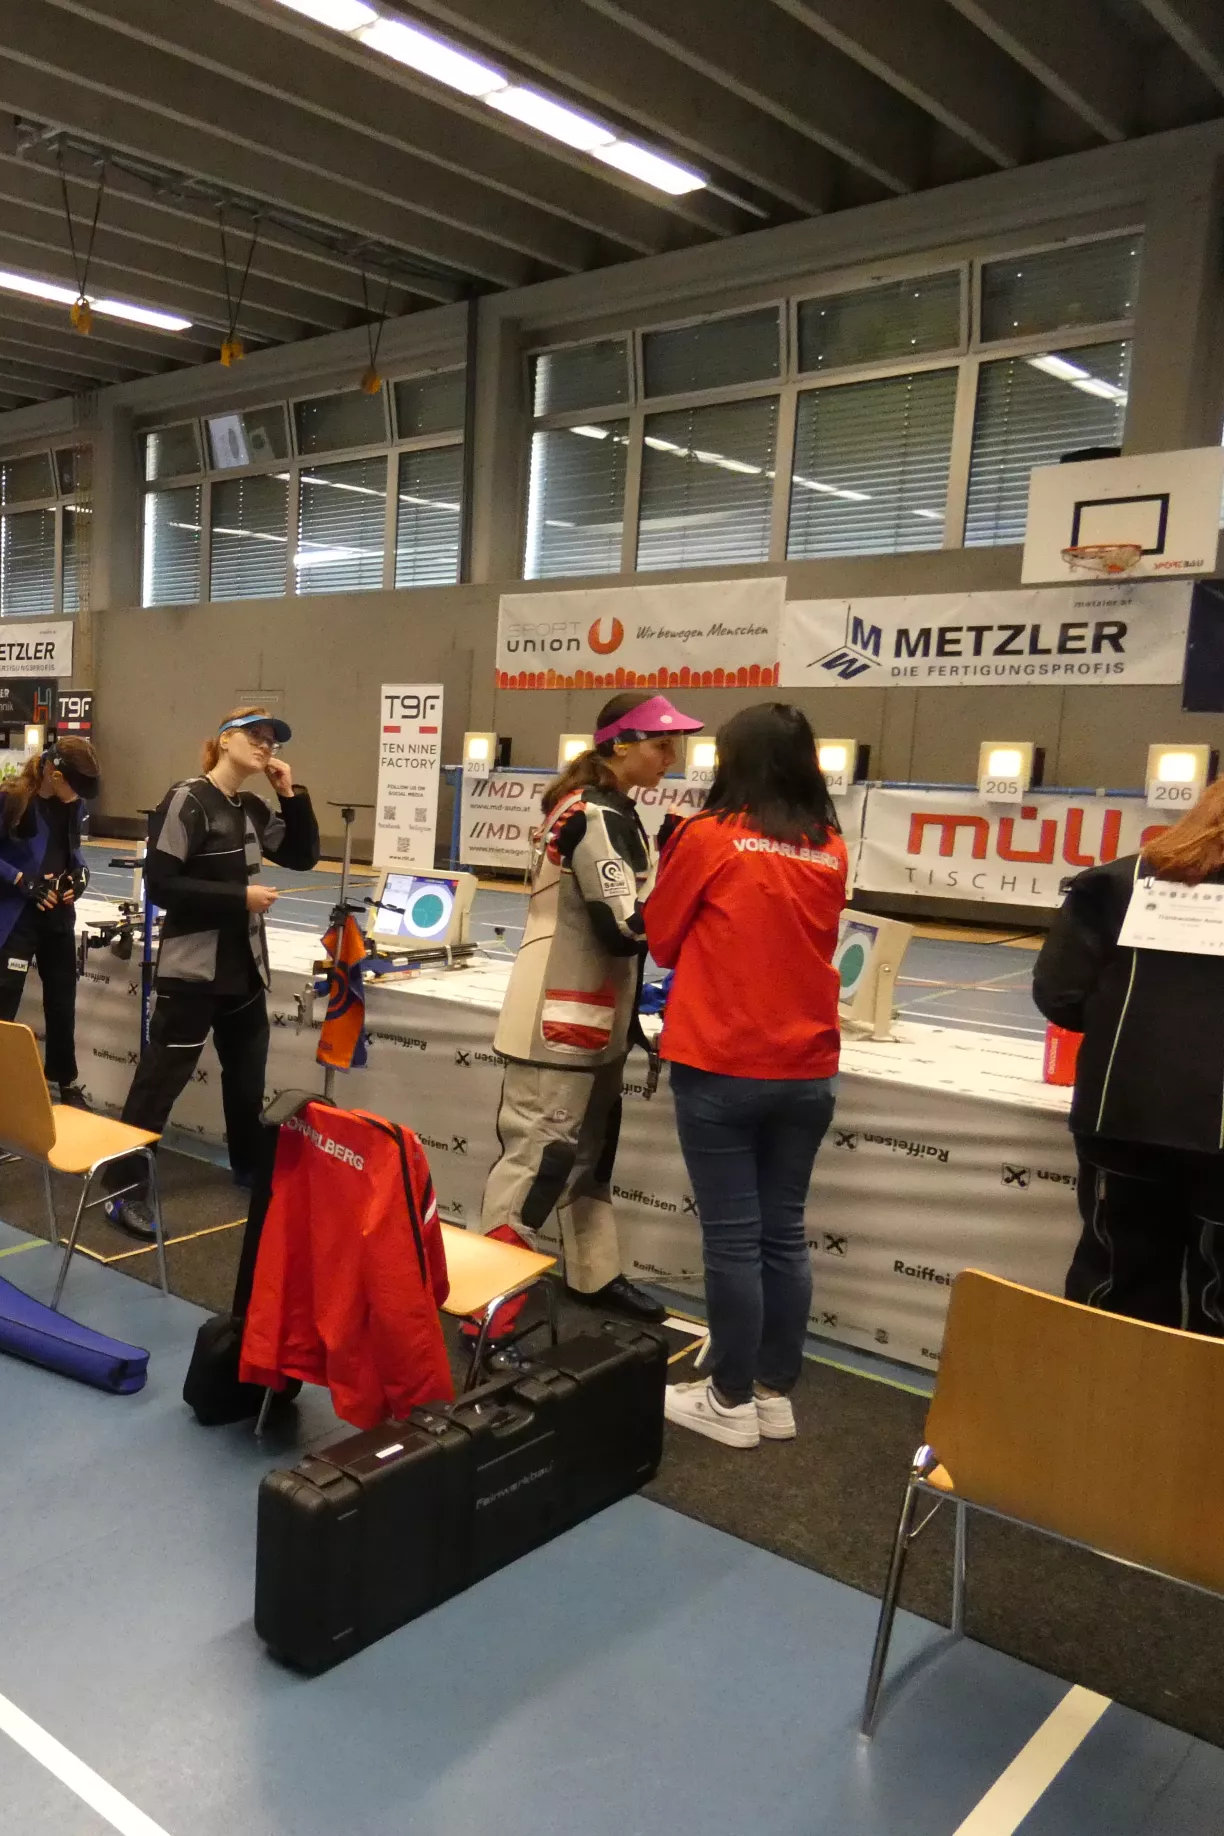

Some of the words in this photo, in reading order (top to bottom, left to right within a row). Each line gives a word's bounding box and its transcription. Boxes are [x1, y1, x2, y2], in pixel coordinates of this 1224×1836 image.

[508, 621, 582, 638] SPORT
[636, 626, 656, 640] Wir
[657, 624, 704, 643] bewegen
[706, 622, 769, 638] Menschen
[506, 638, 581, 653] union
[893, 620, 1127, 659] METZLER
[891, 665, 920, 678] DIE
[927, 662, 1126, 678] FERTIGUNGSPROFIS
[59, 697, 92, 718] T9F
[384, 695, 440, 720] T9F
[382, 743, 405, 753] TEN
[408, 744, 437, 755] NINE
[381, 757, 437, 770] FACTORY
[467, 761, 486, 773] 201
[826, 775, 843, 787] 04
[986, 781, 1018, 795] 205
[1154, 786, 1192, 801] 206
[470, 803, 531, 813] www.md-auto.at
[733, 837, 839, 871] VORARLBERG
[376, 1032, 427, 1051] Raiffeisen
[93, 1048, 126, 1064] Raiffeisen
[863, 1132, 949, 1164] Raiffeisen
[612, 1184, 678, 1213] Raiffeisen
[893, 1259, 954, 1287] Raiffei
